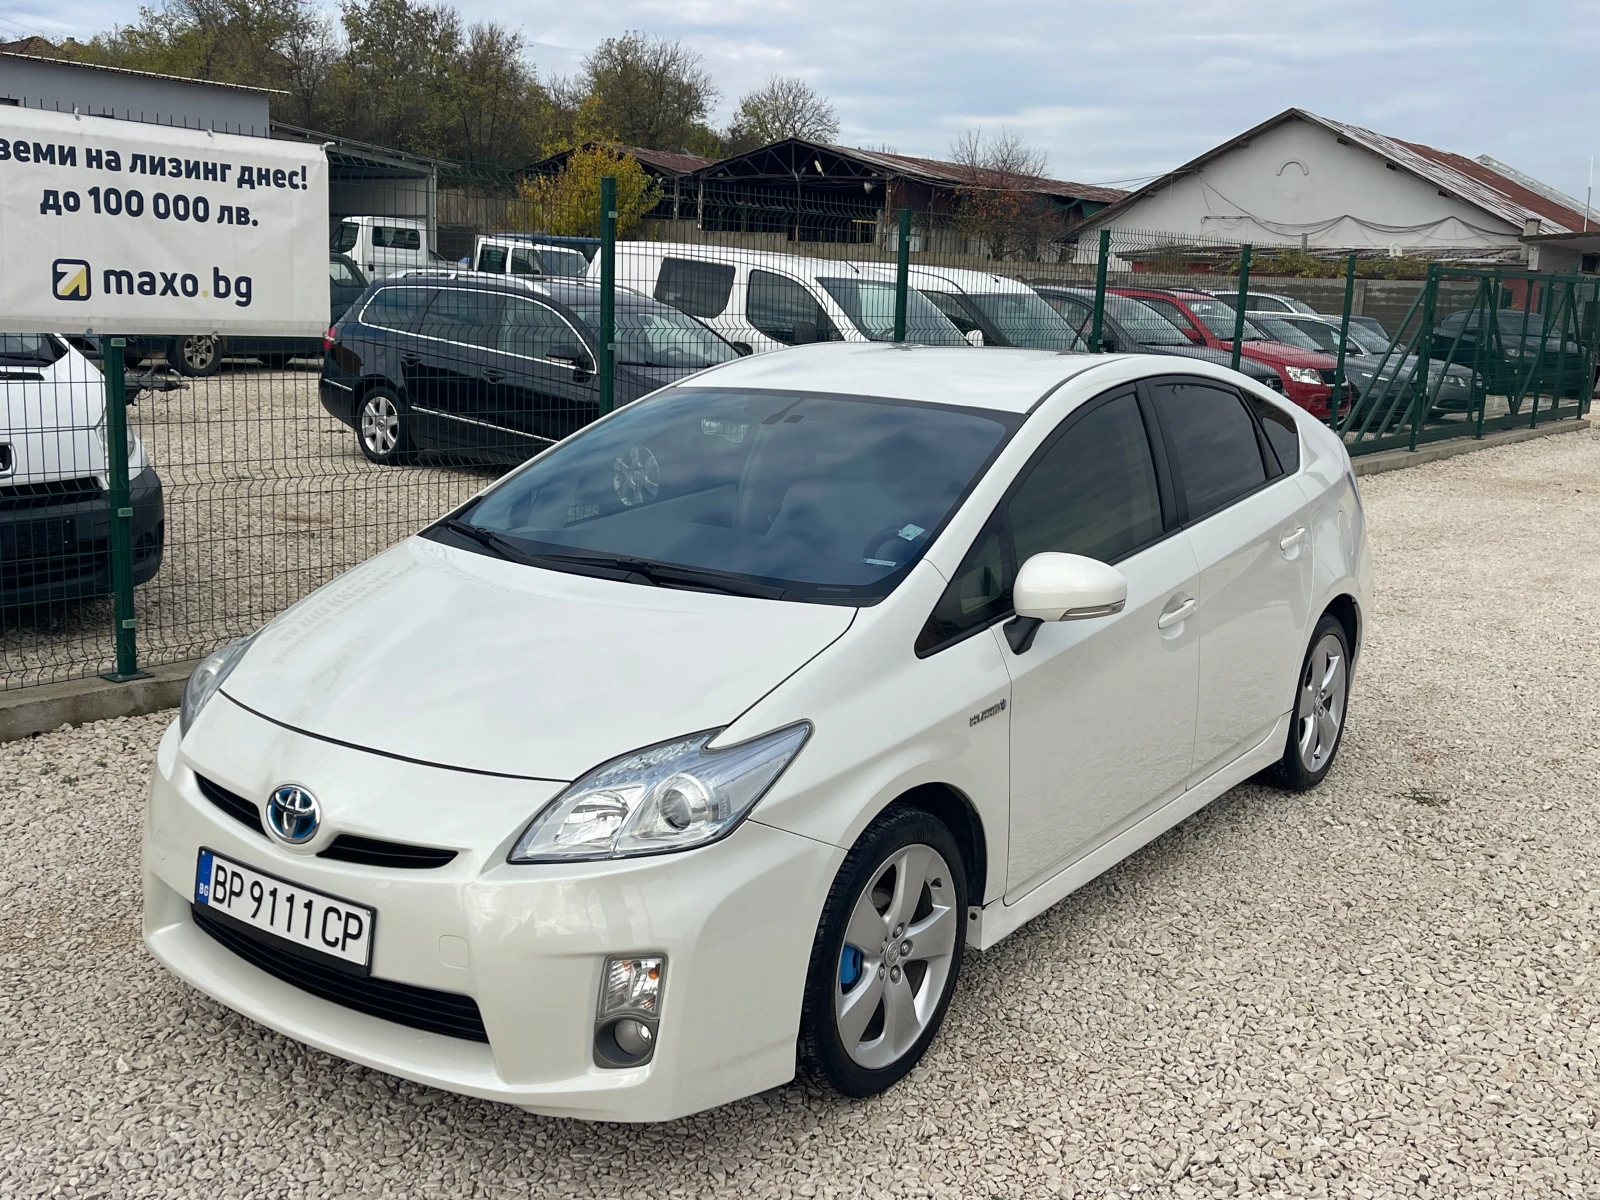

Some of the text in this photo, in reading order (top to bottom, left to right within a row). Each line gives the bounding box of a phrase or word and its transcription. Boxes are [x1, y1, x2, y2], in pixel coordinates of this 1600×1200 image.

[86, 148, 122, 172] на
[129, 153, 232, 183] лизинг
[237, 165, 308, 190] днес!
[40, 186, 259, 227] до 100 000 лв.
[103, 266, 252, 308] maxo.bg
[199, 882, 209, 897] BG
